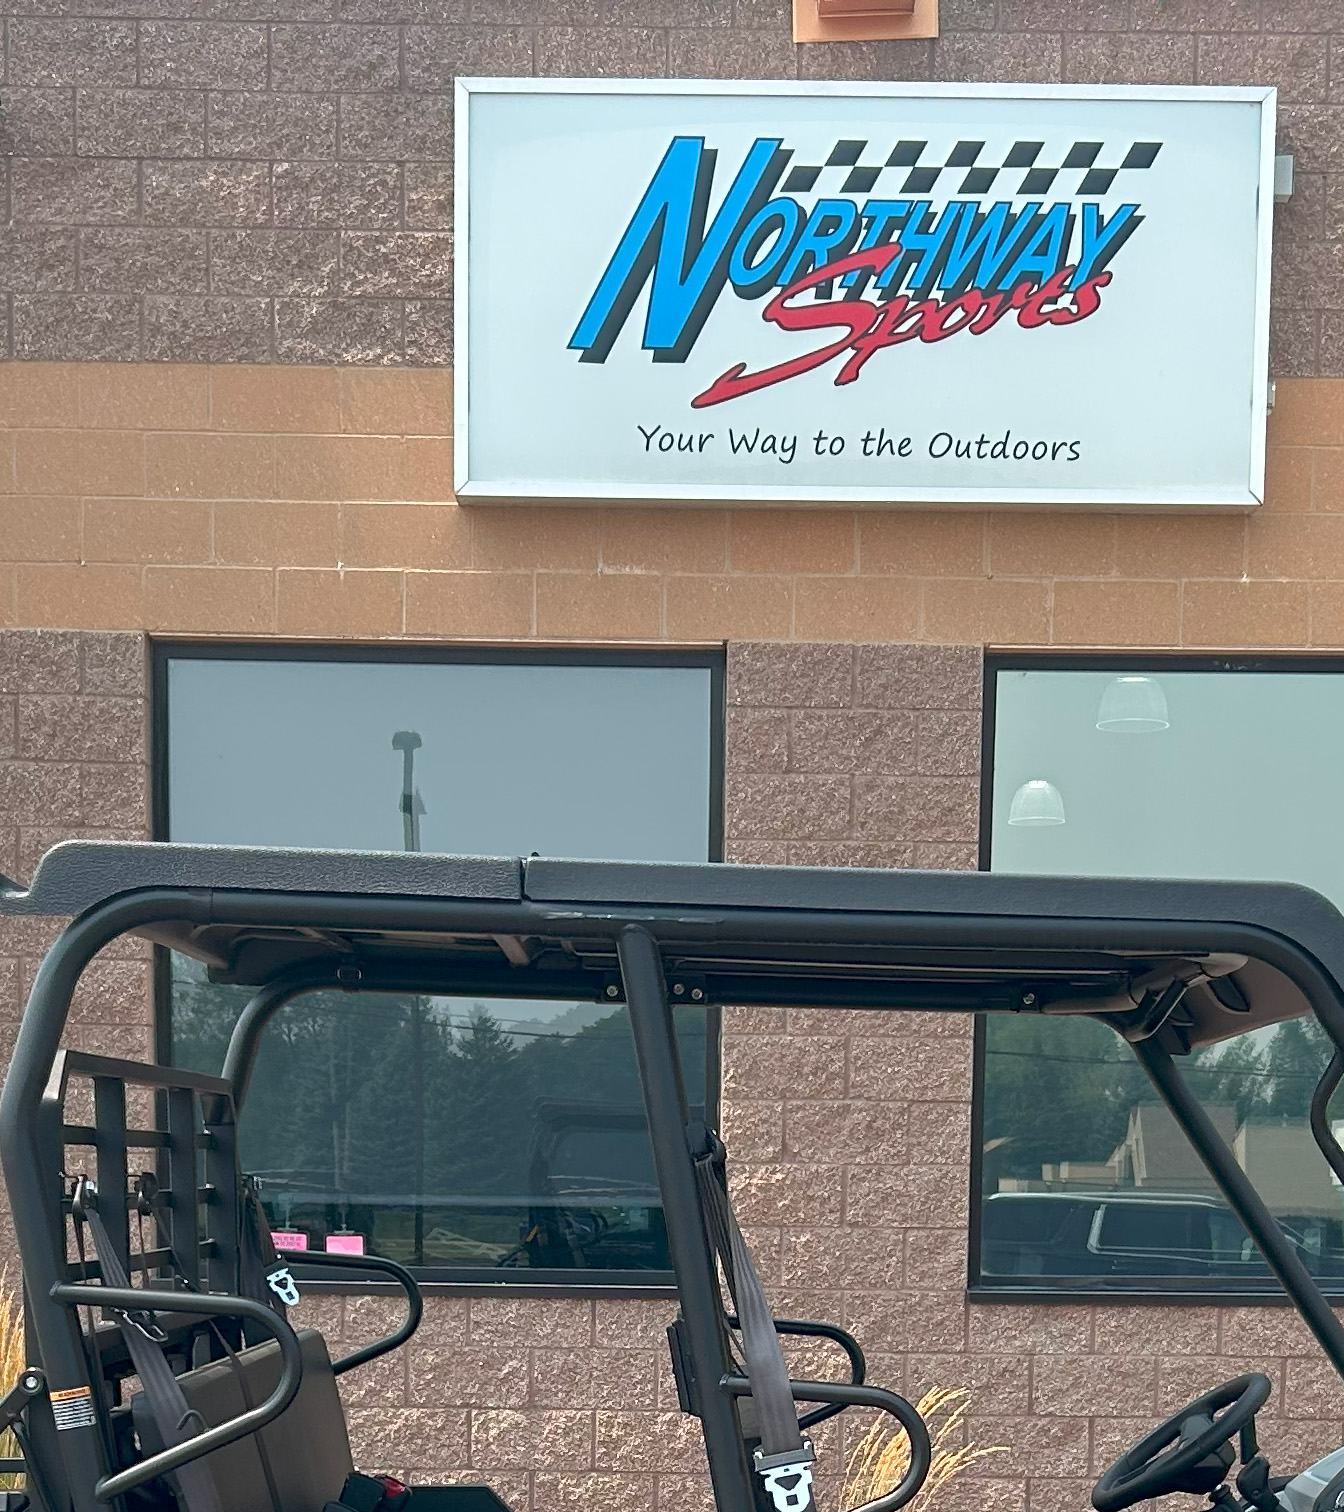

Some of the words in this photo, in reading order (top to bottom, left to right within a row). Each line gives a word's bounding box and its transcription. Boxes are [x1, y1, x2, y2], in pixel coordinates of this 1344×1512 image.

[568, 135, 1144, 363] NORTHWAY
[690, 243, 1111, 409] Sports
[637, 424, 715, 454] Your
[728, 428, 798, 464] Way
[812, 429, 846, 456] to
[860, 428, 913, 459] the
[928, 431, 1082, 462] Outdoors
